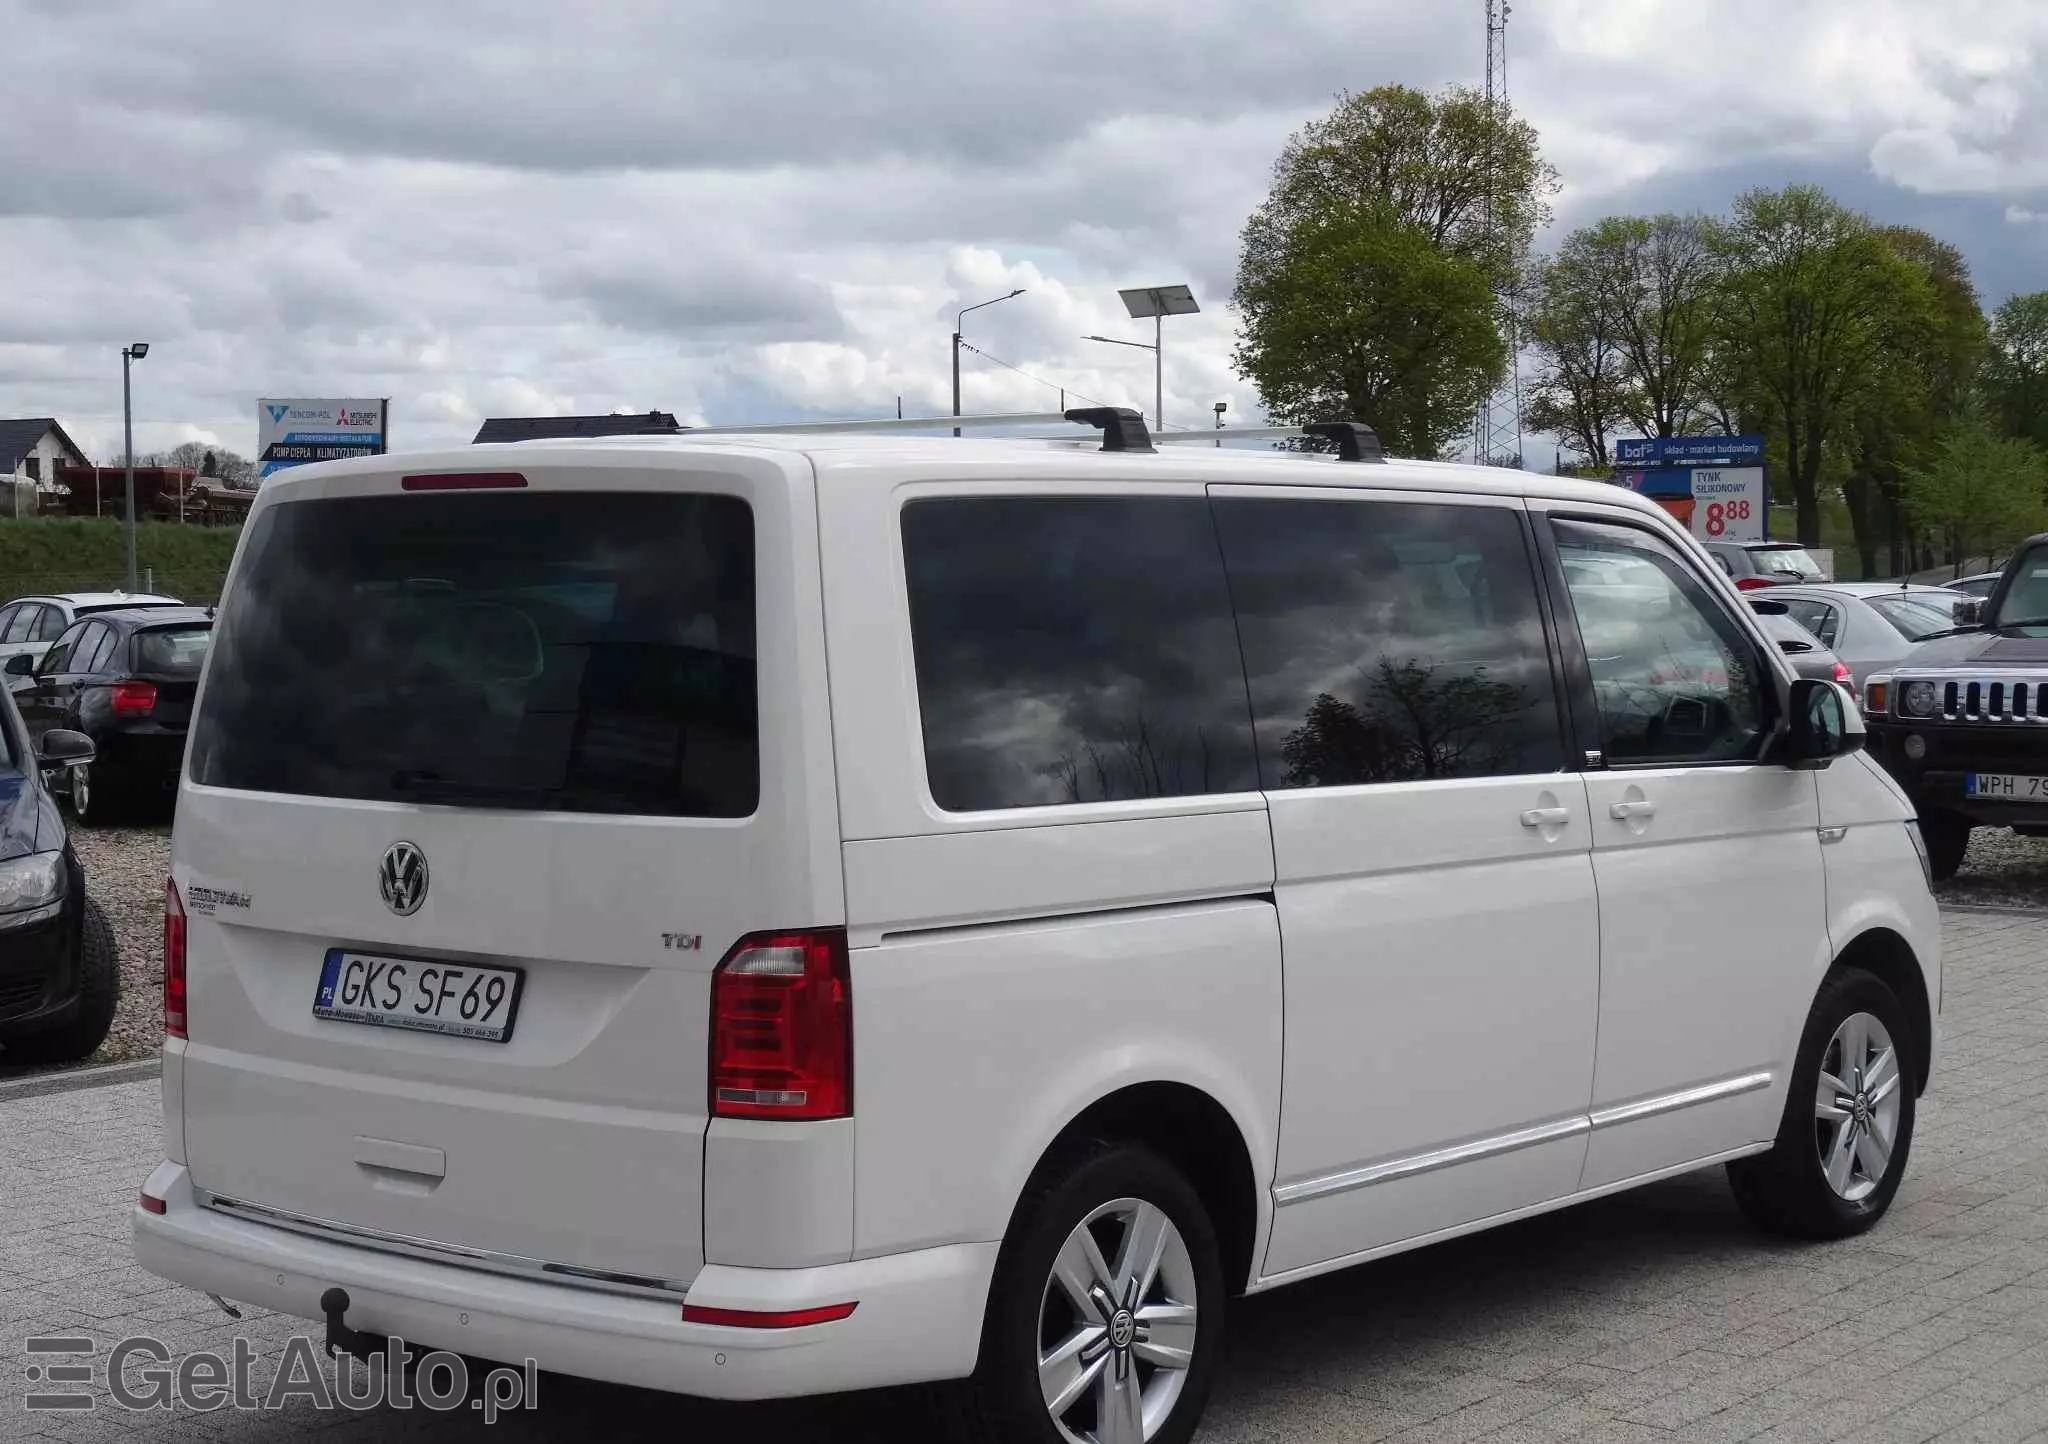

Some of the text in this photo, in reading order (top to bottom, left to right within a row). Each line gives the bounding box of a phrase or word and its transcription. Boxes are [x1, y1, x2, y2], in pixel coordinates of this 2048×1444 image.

[272, 447, 289, 457] POMP
[290, 447, 311, 458] CIEPŁA
[1689, 445, 1716, 454] market
[1717, 443, 1759, 455] budowlany
[1695, 472, 1721, 482] TYNK
[1695, 483, 1746, 494] SILIKONOWY
[1979, 776, 2014, 794] WPH
[661, 933, 702, 950] TDI
[321, 986, 334, 1000] PL
[341, 960, 506, 1022] GKS SF69
